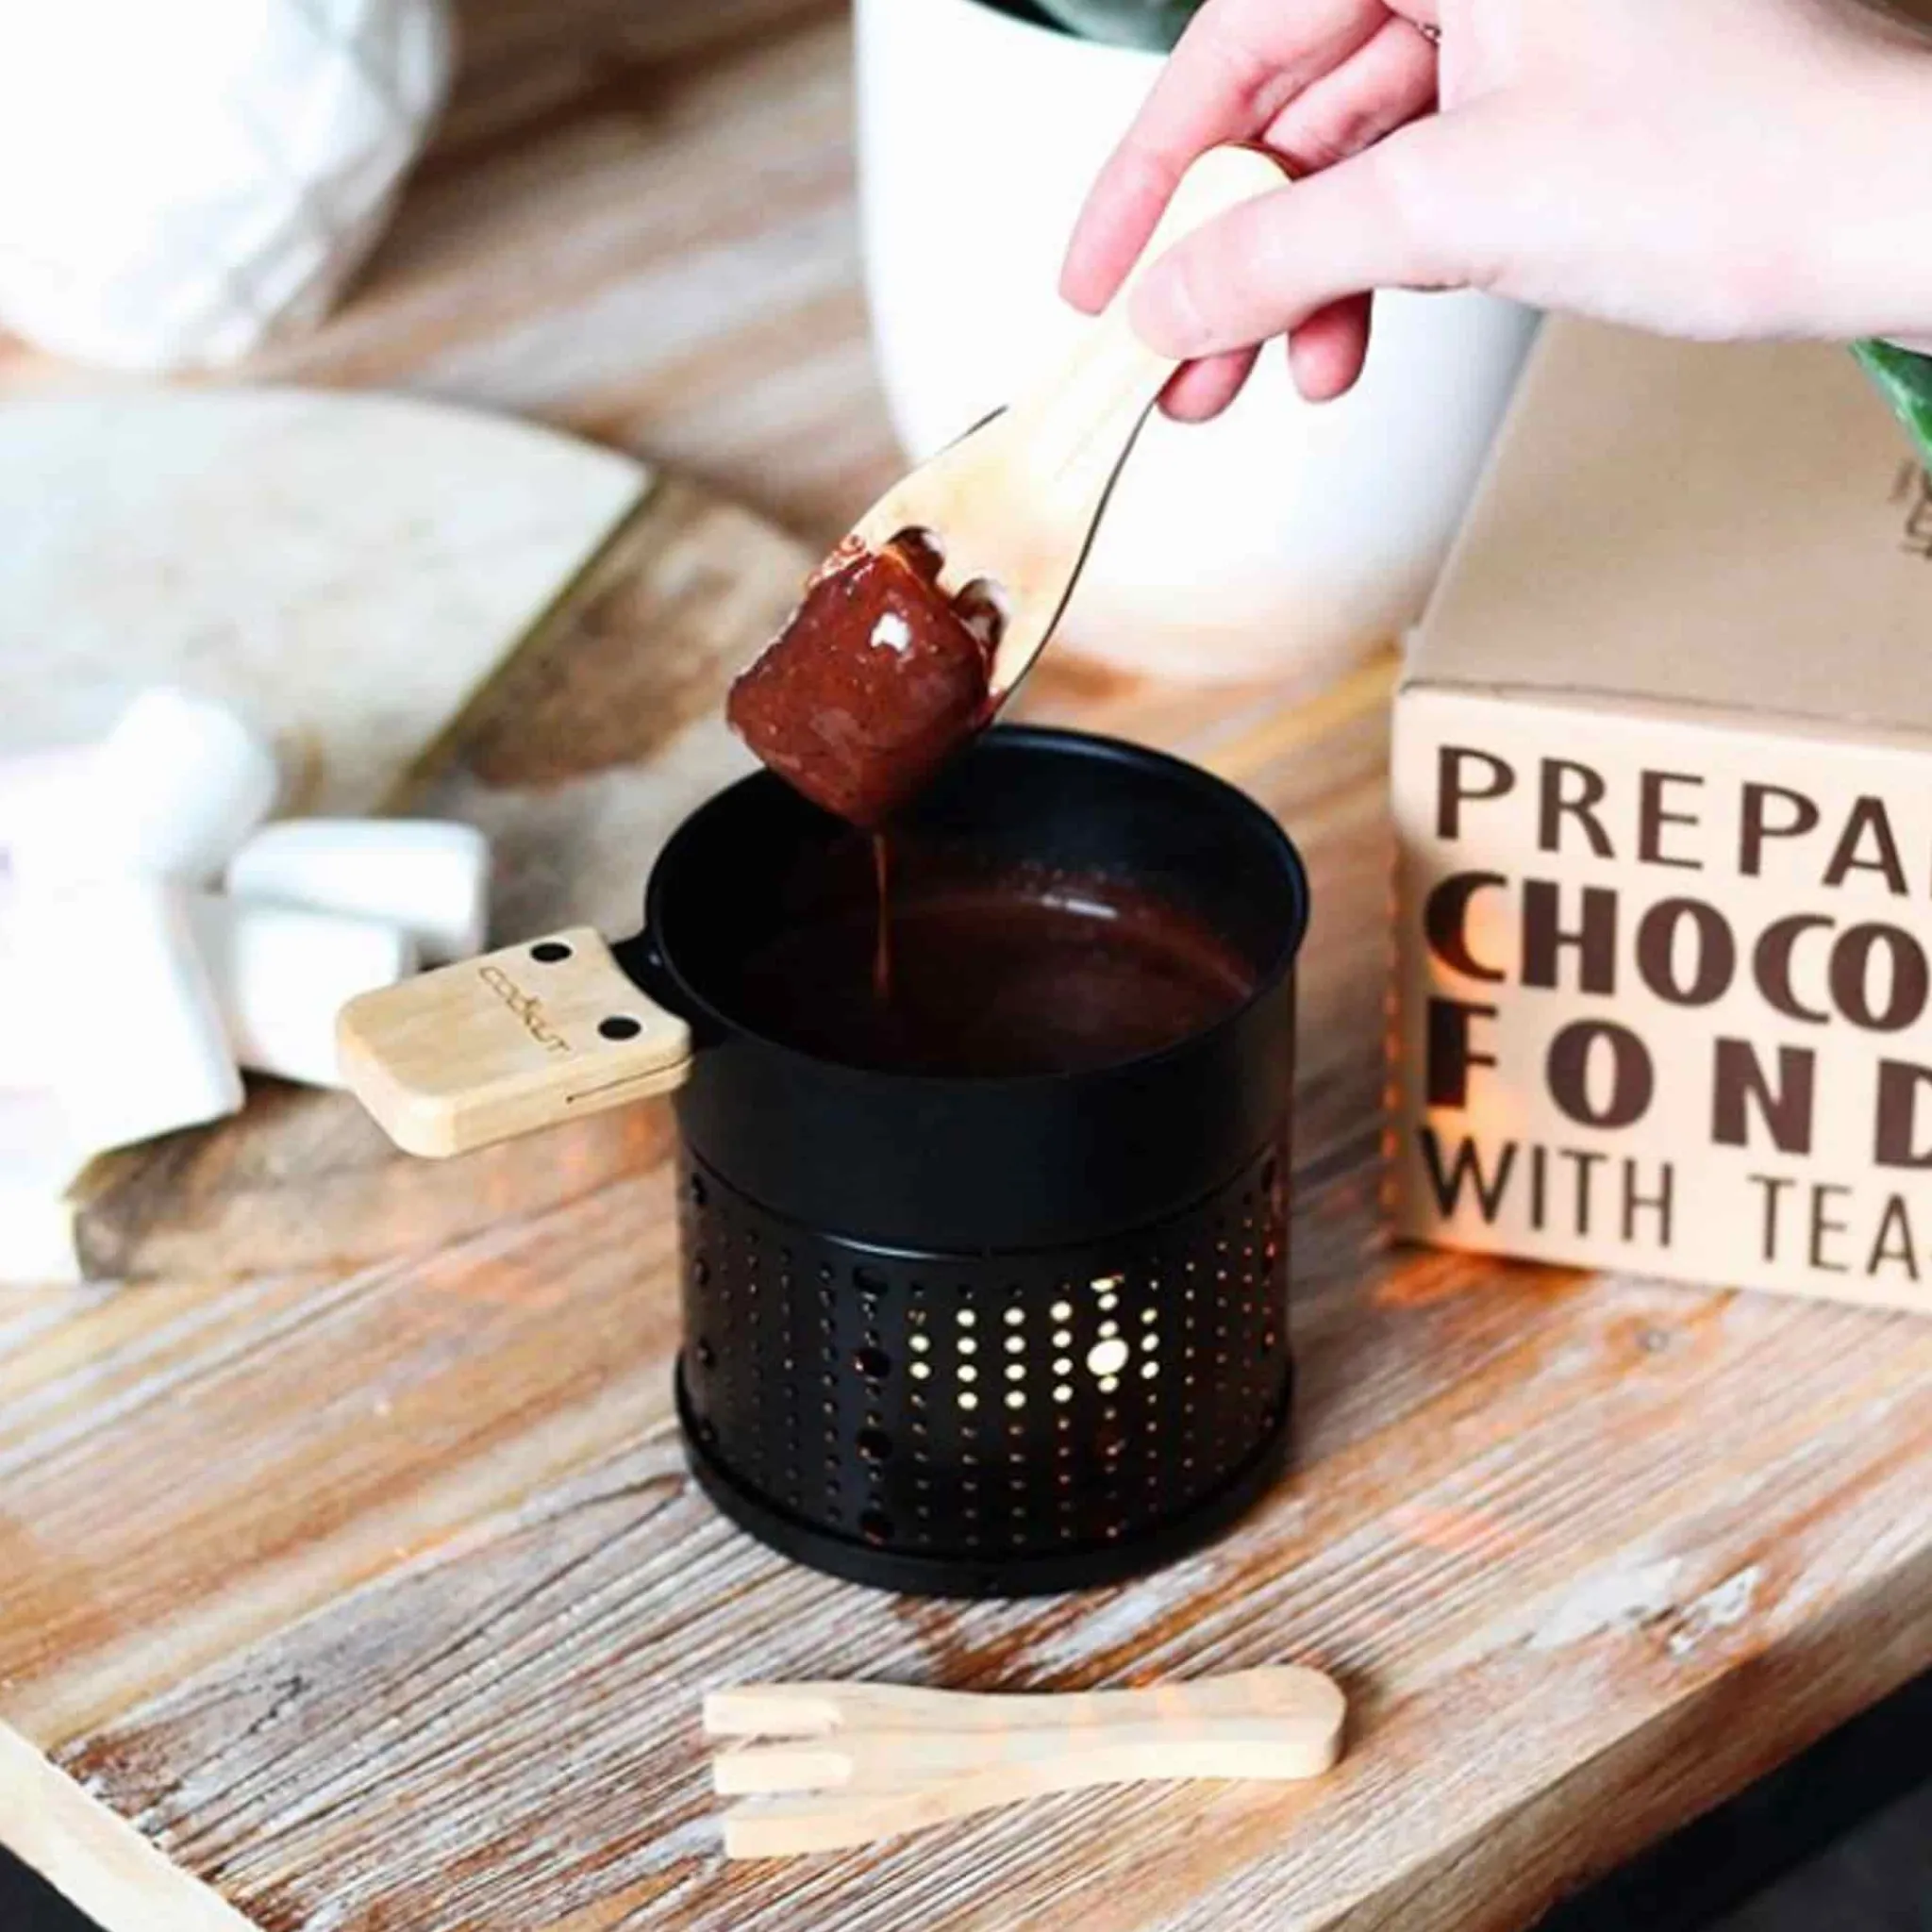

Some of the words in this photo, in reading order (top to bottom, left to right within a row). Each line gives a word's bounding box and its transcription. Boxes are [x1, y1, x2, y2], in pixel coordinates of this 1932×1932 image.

[1436, 744, 1932, 898] PREPA
[1424, 871, 1930, 1033] CHOCO
[1419, 1124, 1674, 1248] WITH
[1746, 1174, 1932, 1282] TEA
